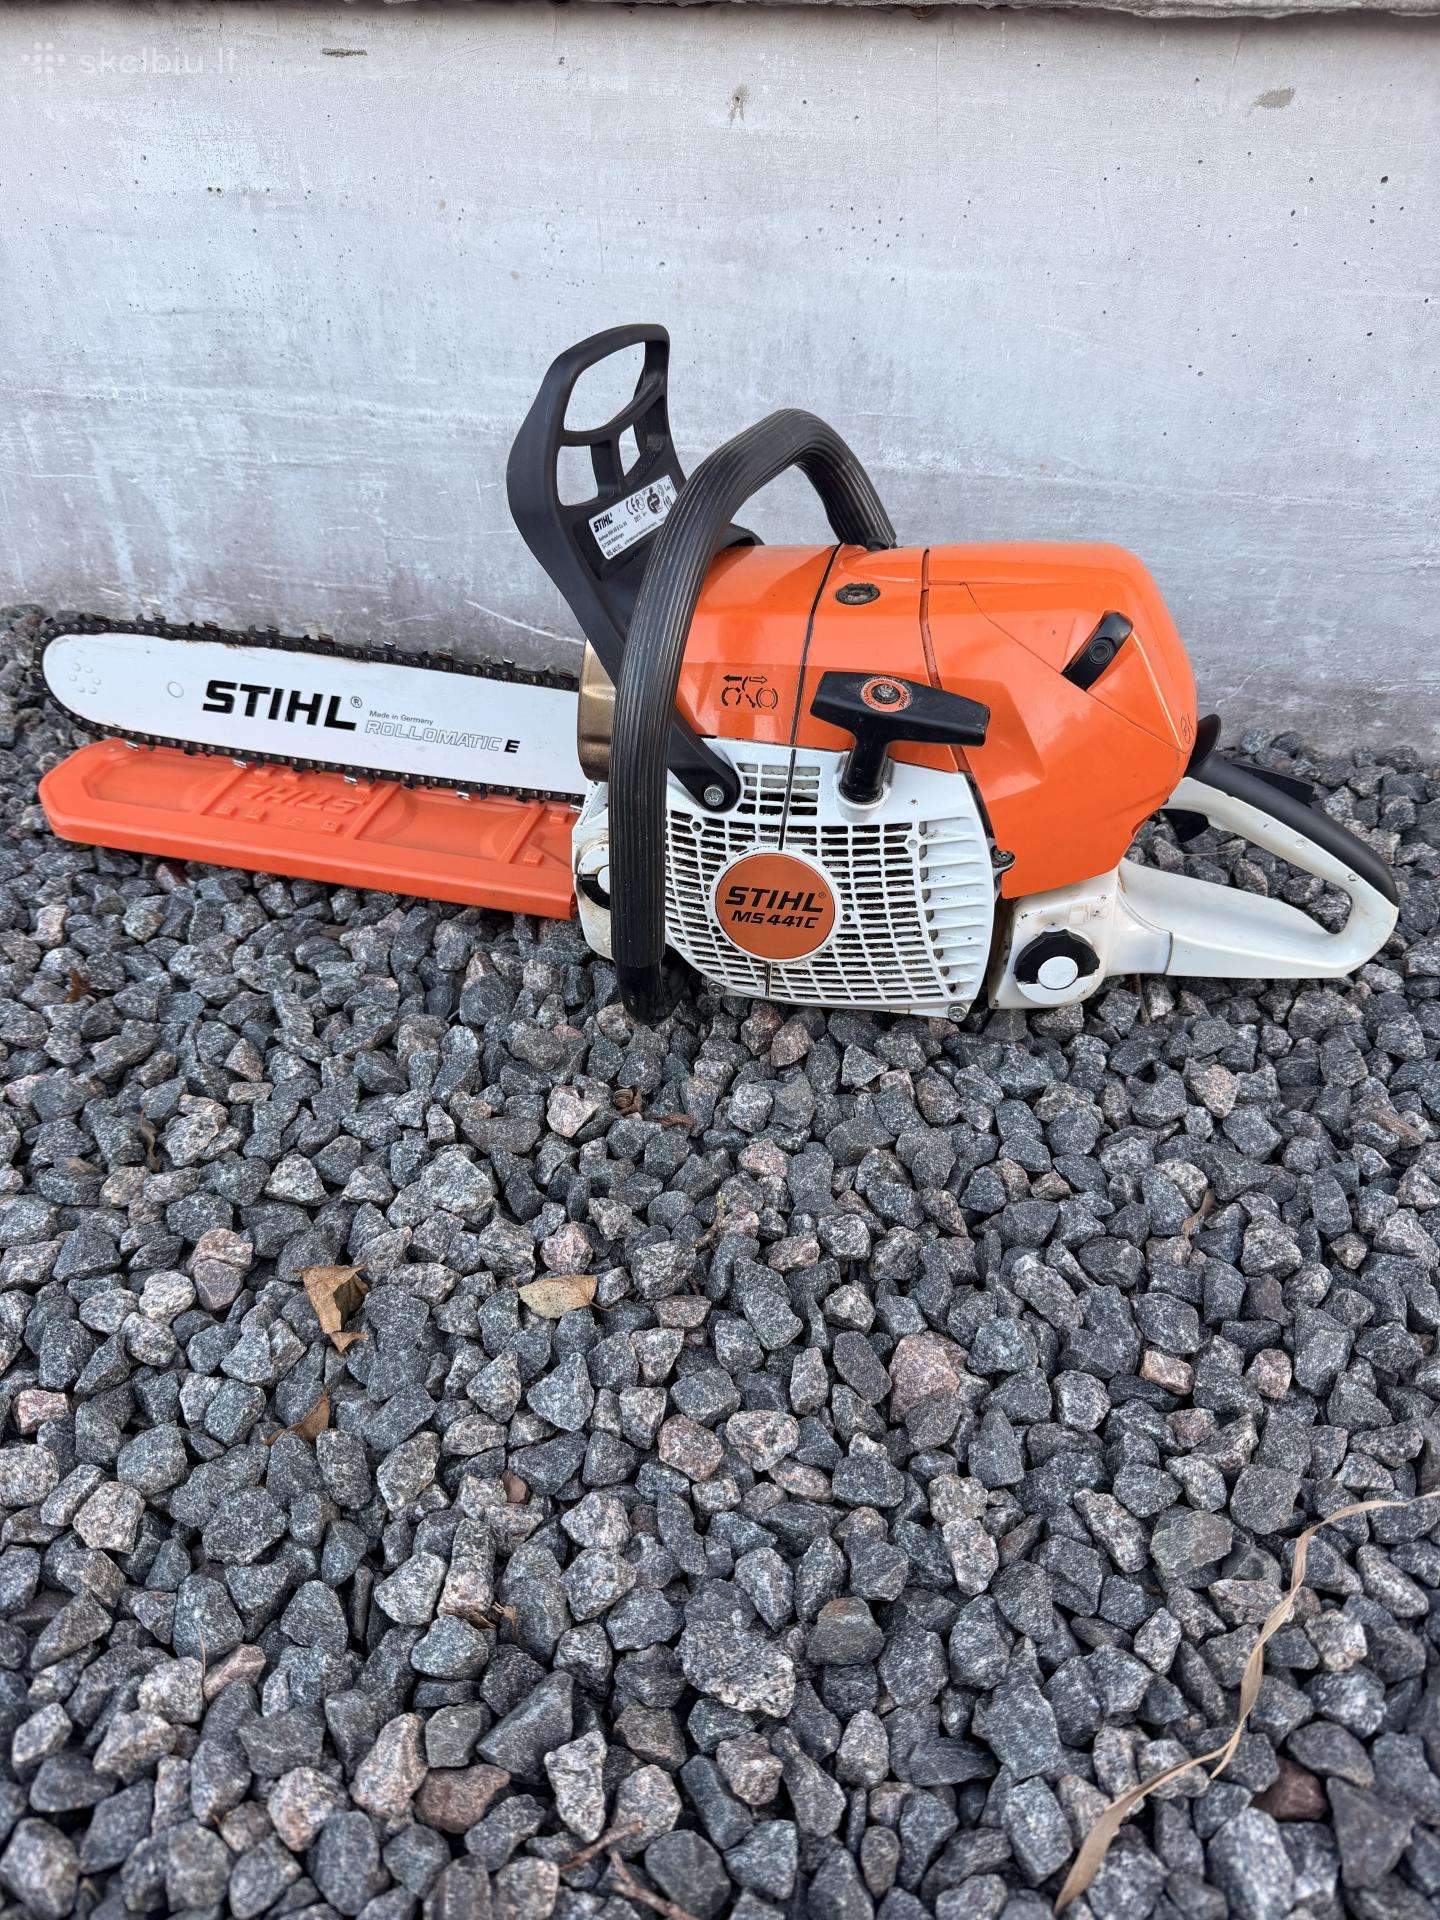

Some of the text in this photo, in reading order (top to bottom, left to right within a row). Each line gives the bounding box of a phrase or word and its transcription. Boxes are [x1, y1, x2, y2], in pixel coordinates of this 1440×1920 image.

[593, 513, 613, 534] STIHL
[369, 710, 434, 726] Made in Germany
[365, 720, 520, 754] ROLLOMATIC E
[731, 910, 819, 929] MS 441C
